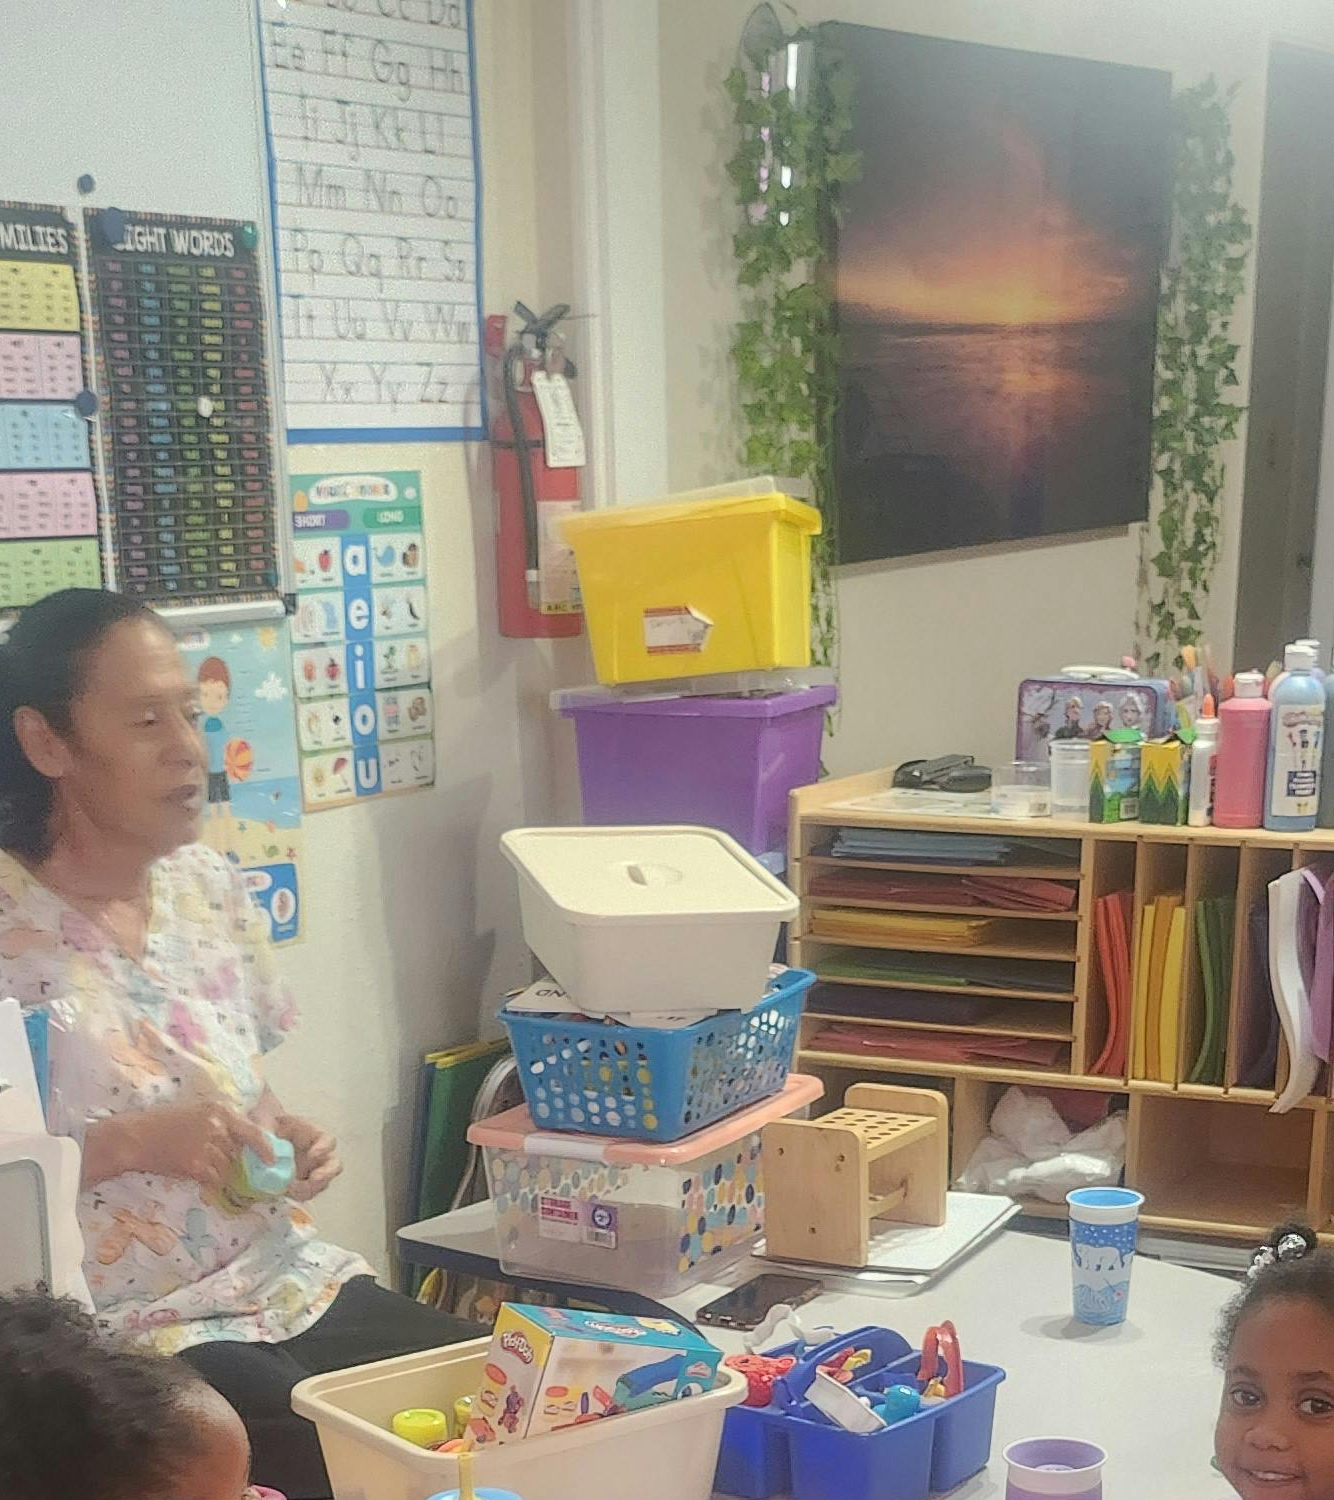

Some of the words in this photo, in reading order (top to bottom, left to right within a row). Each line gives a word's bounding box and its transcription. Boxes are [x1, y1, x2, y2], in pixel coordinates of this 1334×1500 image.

[113, 226, 167, 254] IGHT
[170, 228, 235, 258] WORDS
[348, 599, 370, 630] e
[354, 644, 365, 690] i
[353, 704, 375, 736] o
